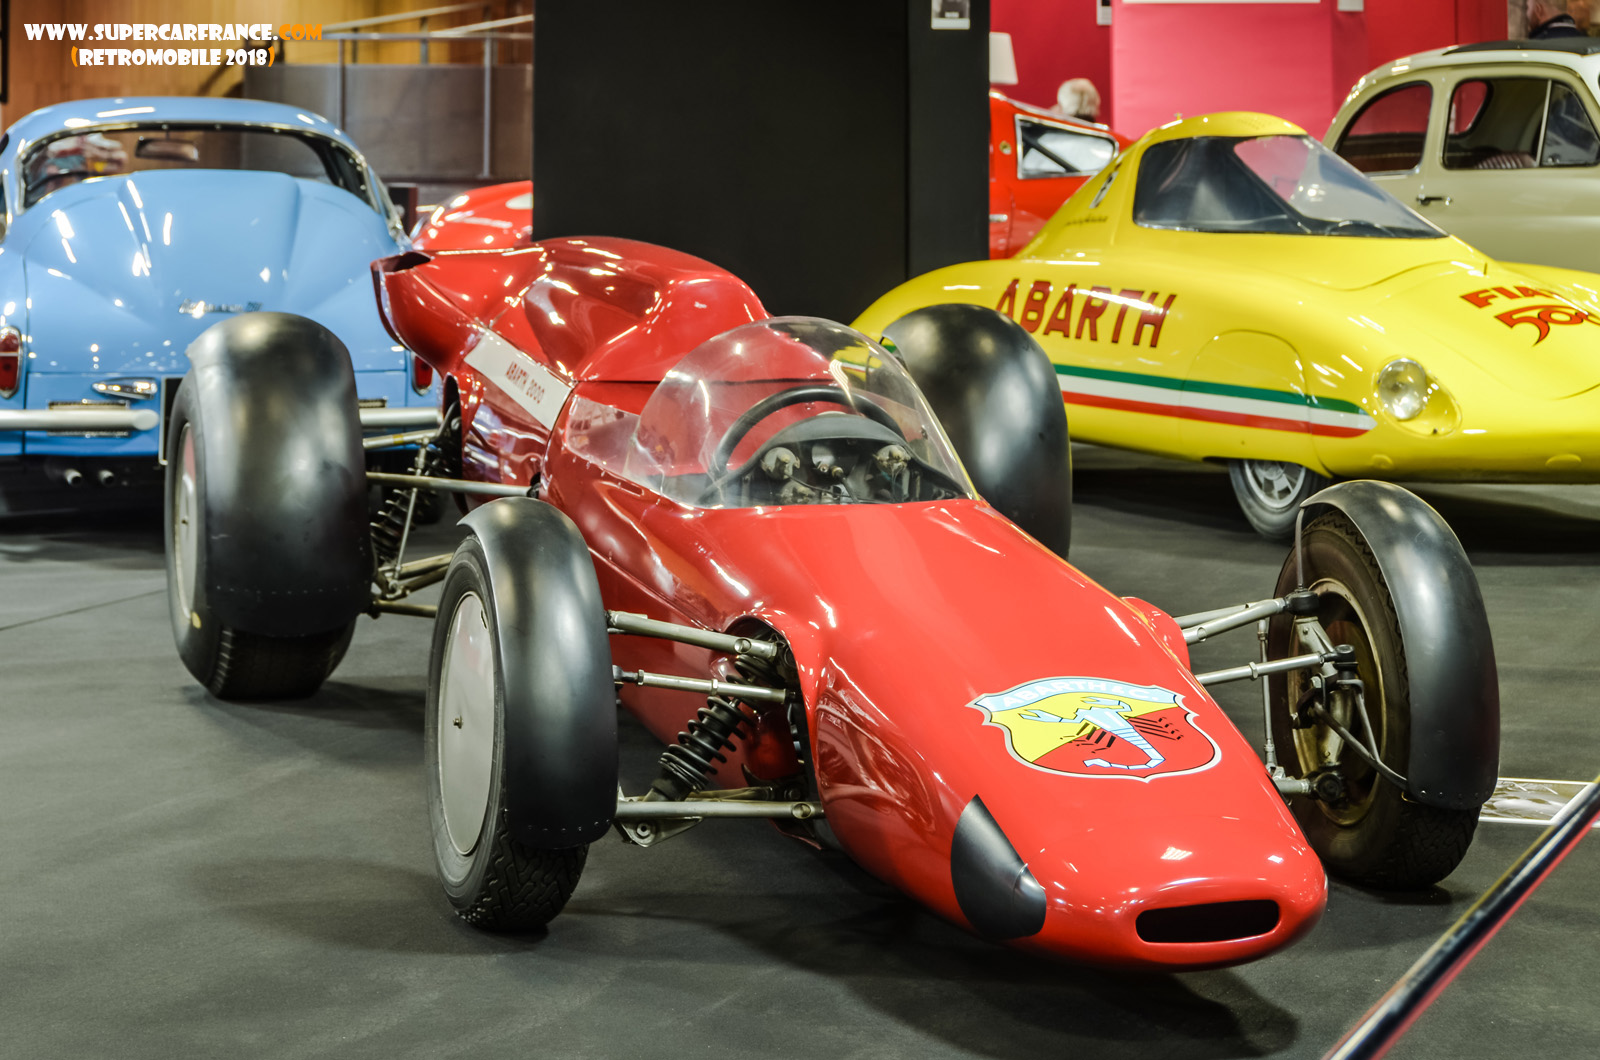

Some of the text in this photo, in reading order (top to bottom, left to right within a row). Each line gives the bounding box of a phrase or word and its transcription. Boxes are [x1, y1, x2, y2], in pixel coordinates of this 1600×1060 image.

[1460, 286, 1556, 309] FIA
[994, 277, 1177, 348] ABARTH
[1002, 680, 1107, 708] ABARTH
